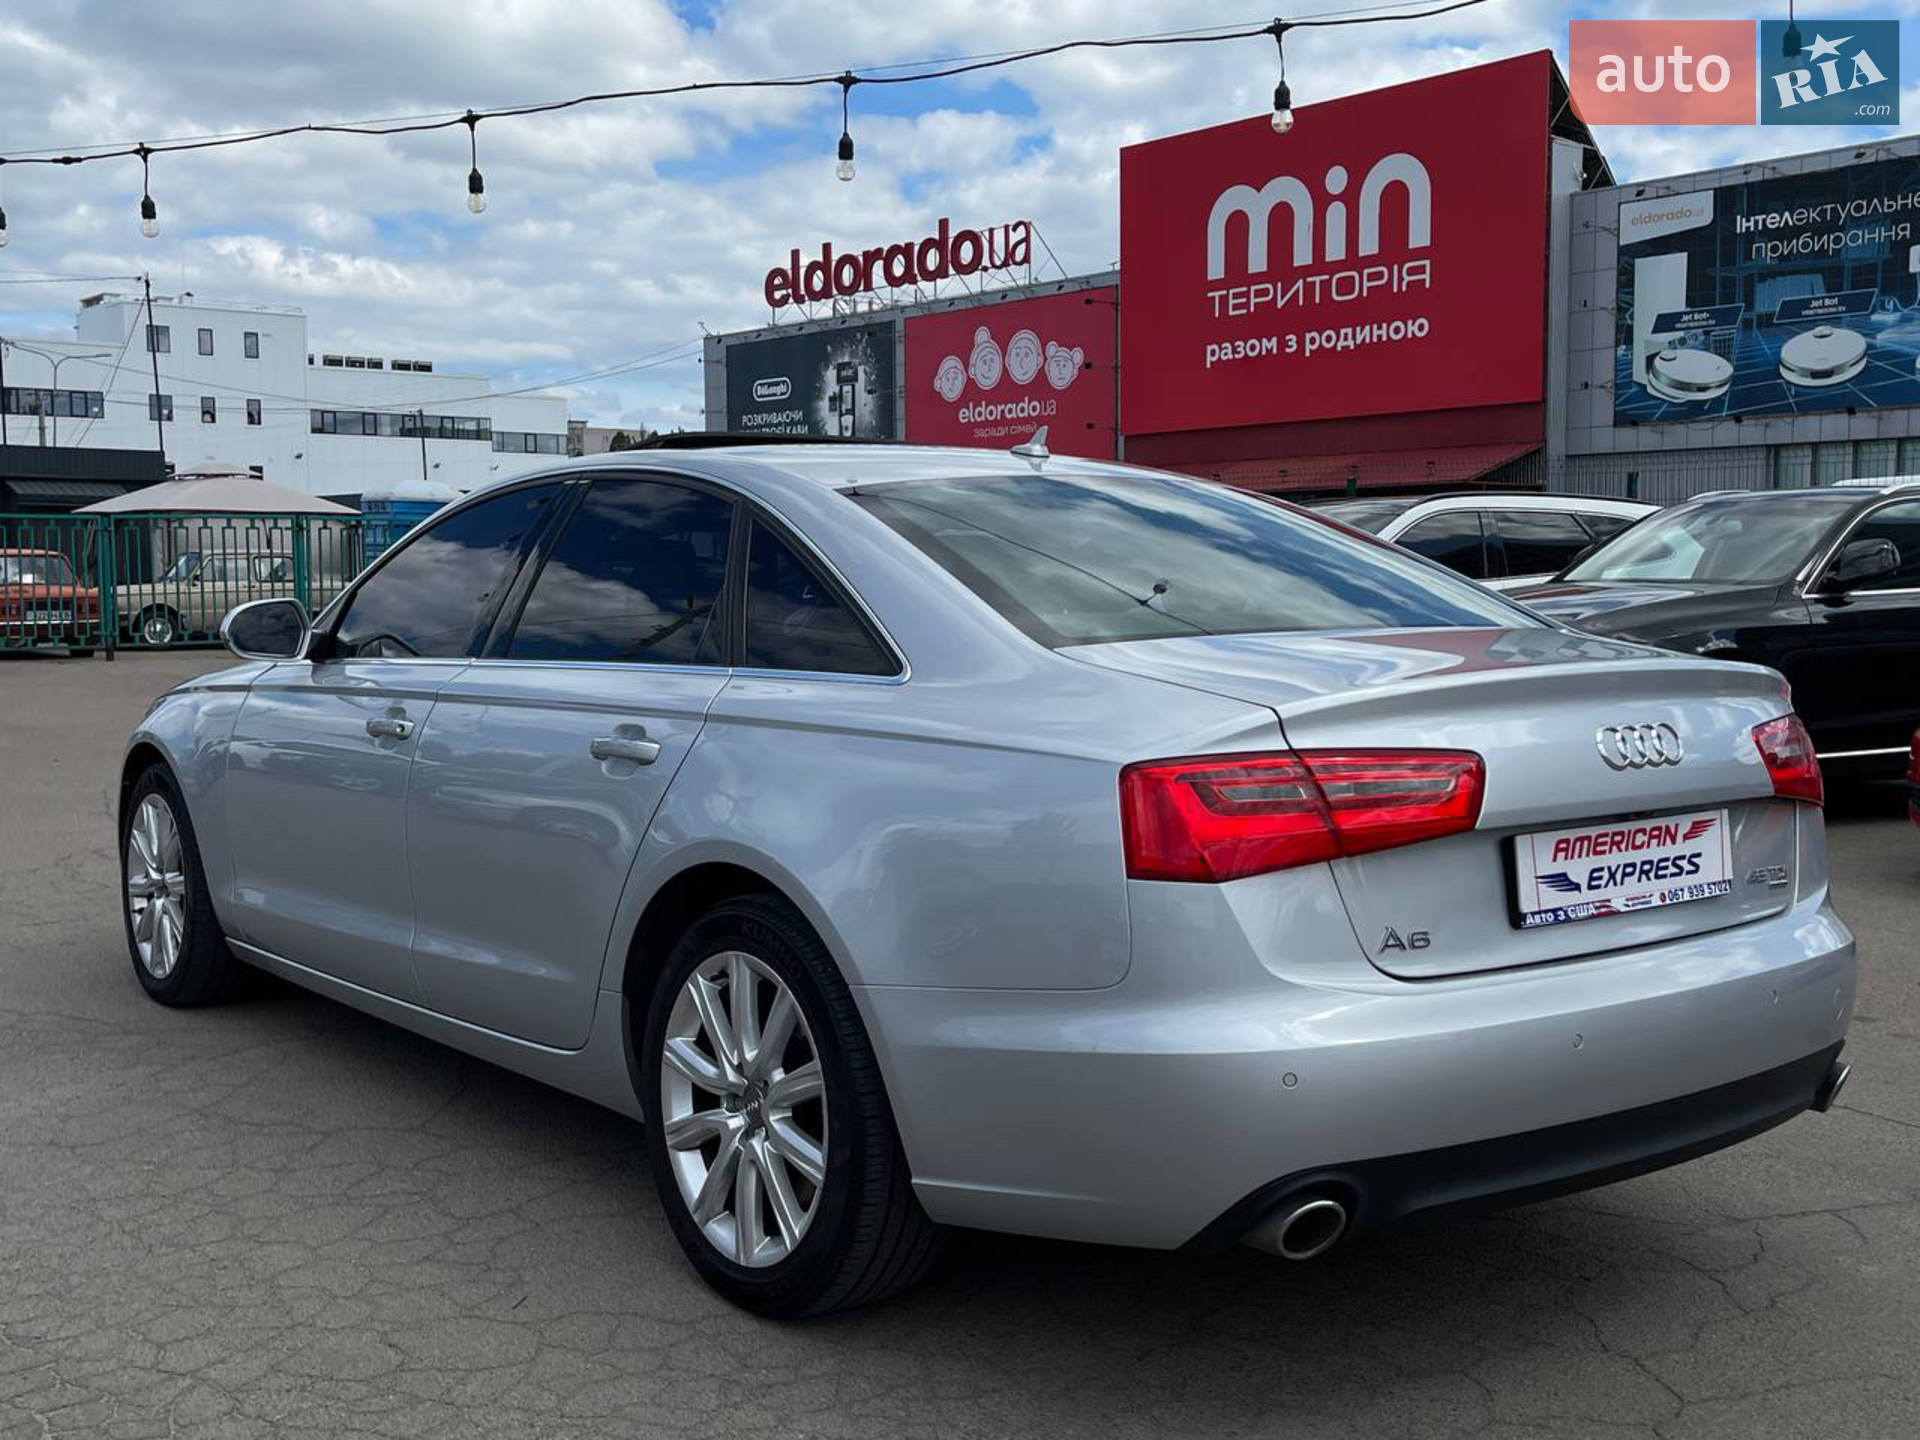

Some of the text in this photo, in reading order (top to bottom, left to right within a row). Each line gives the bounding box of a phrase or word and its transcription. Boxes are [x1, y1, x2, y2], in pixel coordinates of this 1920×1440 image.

[1207, 153, 1432, 281] min
[764, 217, 1032, 308] eldorado.ua
[1751, 222, 1911, 265] прибирання
[1207, 259, 1431, 318] ТЕРИТОРІЯ
[1206, 317, 1429, 368] разом з родиною
[741, 409, 803, 427] РОЗКРИВАЮЧИ
[1552, 823, 1679, 863] AMERICAN
[1587, 852, 1702, 891] EXPRESS
[1377, 926, 1431, 954] A6
